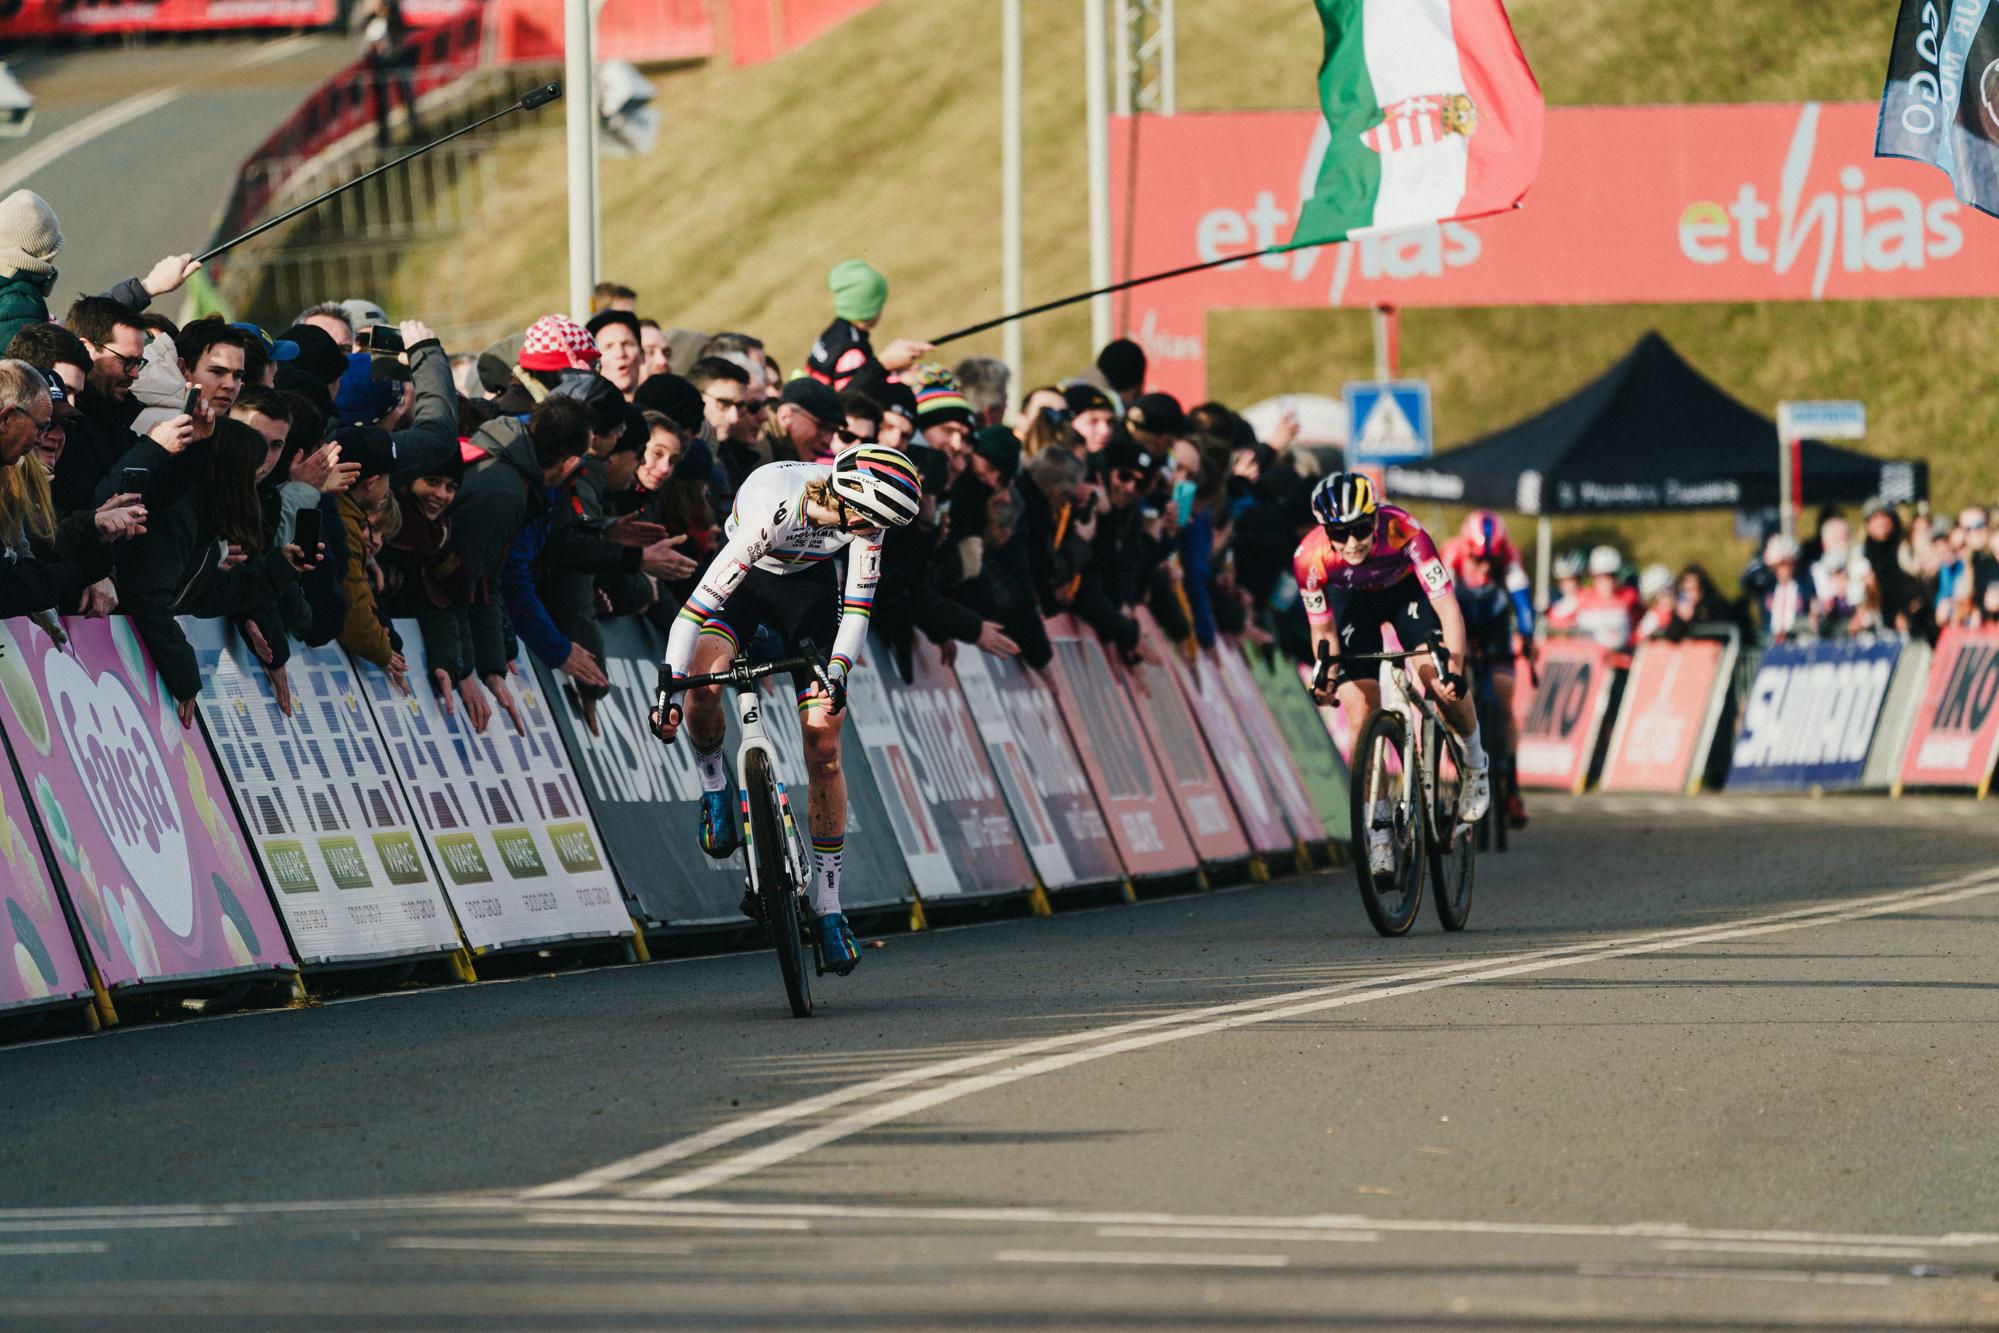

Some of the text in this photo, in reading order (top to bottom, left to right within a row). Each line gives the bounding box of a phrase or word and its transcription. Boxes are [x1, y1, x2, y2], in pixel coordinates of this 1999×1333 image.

[1679, 101, 1964, 300] ethias
[701, 584, 725, 603] SRAM
[1425, 565, 1443, 585] 59
[552, 657, 706, 802] FRISTAD
